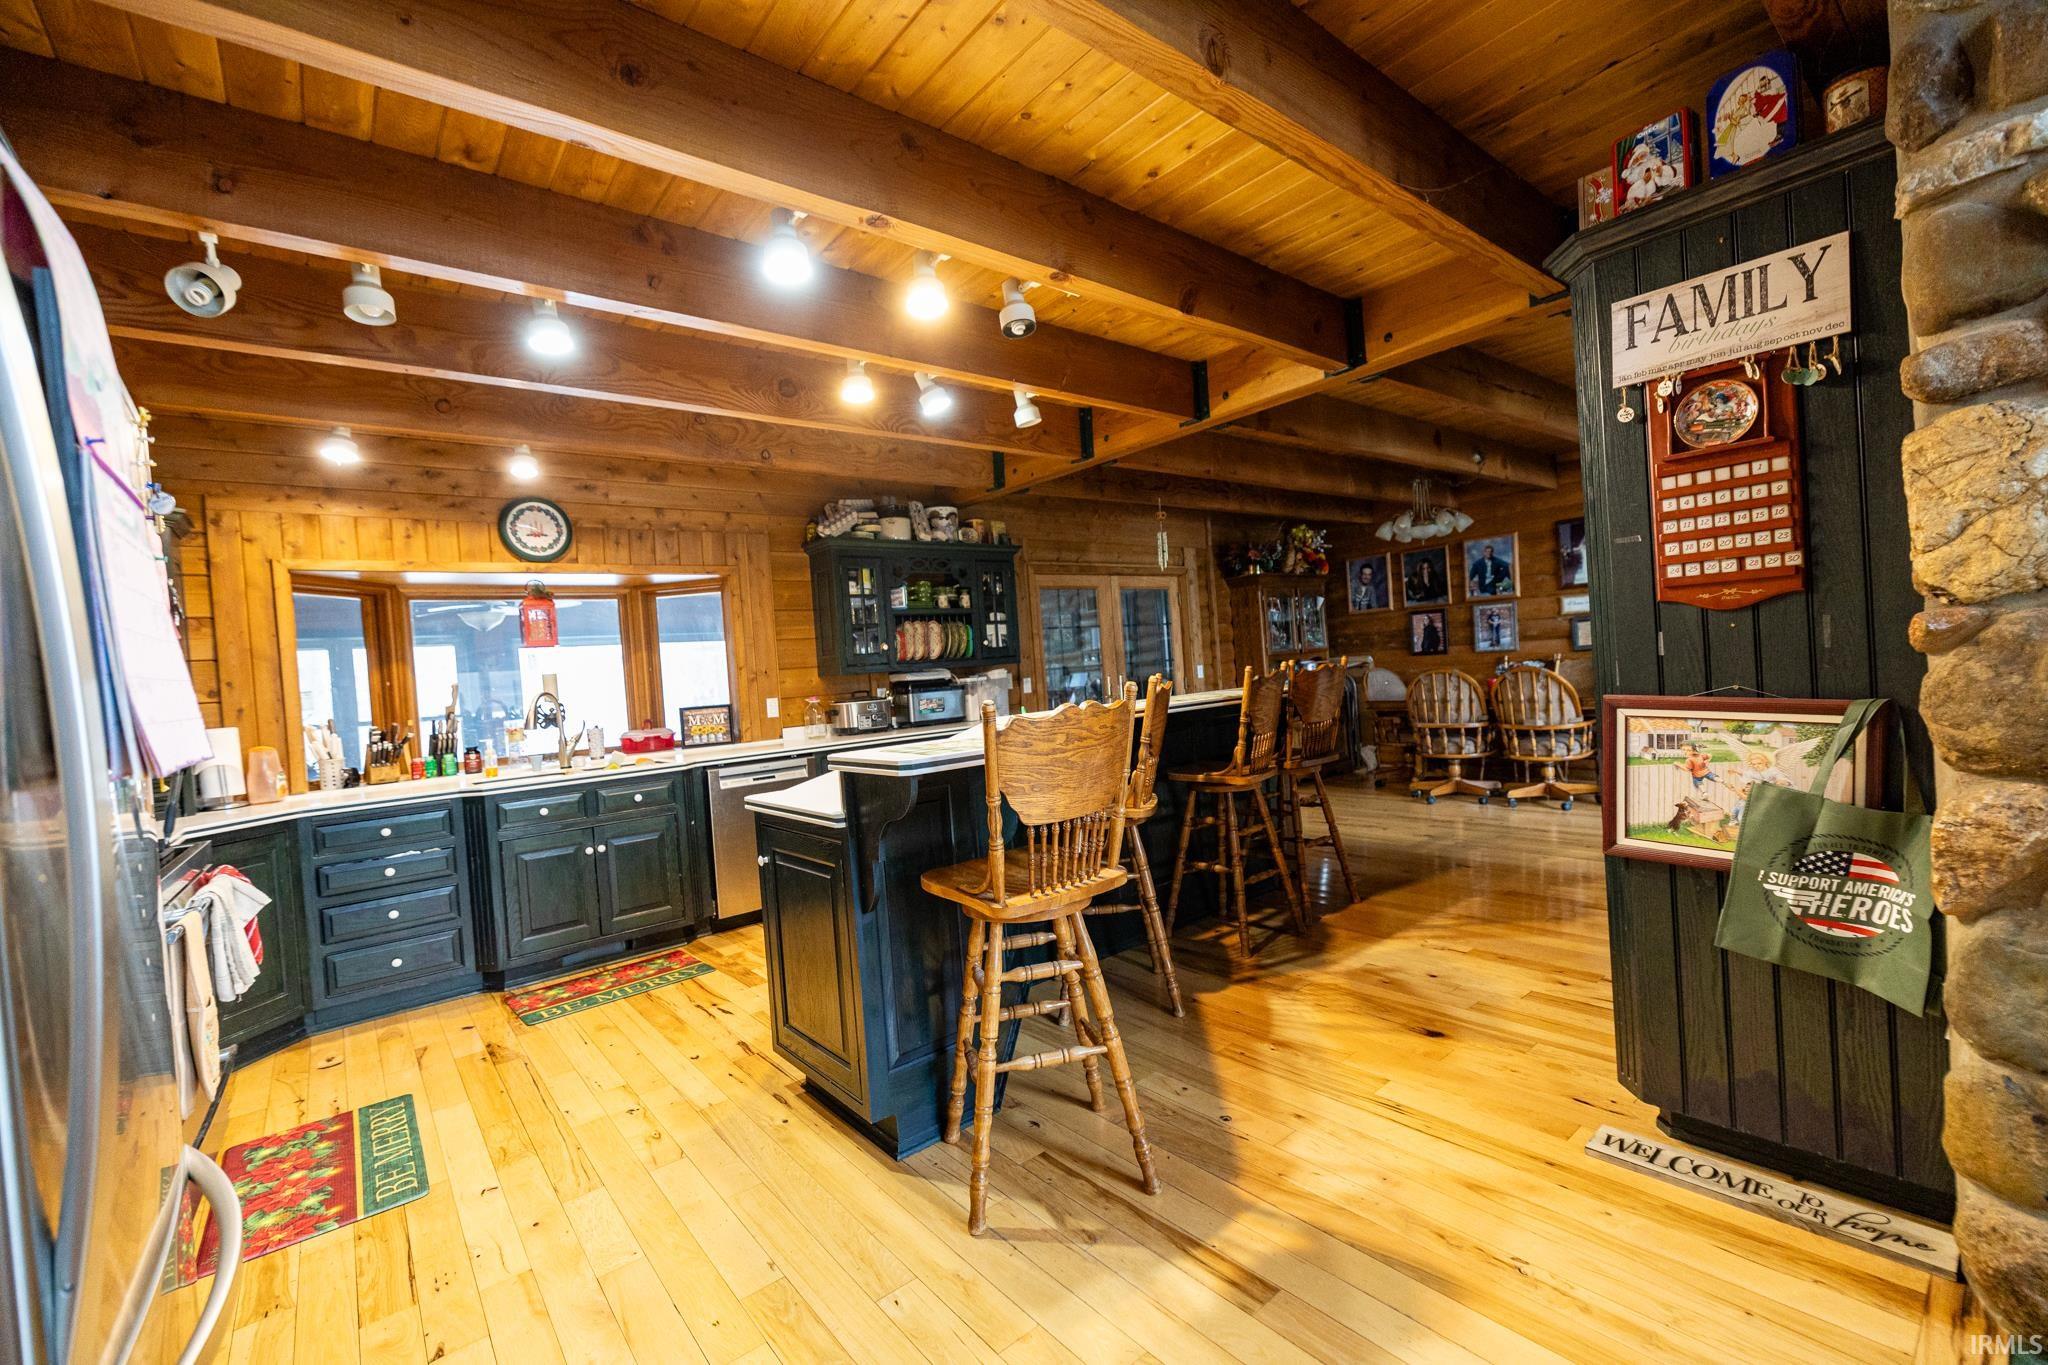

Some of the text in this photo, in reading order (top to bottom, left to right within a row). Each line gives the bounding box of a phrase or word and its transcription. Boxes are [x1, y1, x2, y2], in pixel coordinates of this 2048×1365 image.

[1625, 244, 1832, 351] FAMILY
[1617, 320, 1846, 384] jan feb mar apr may jun jul aug sep oct nov dec
[1668, 315, 1777, 353] birthdays
[1757, 869, 1917, 907] I SUPPORT AMERICA'S
[1807, 892, 1915, 934] HEROES
[538, 965, 703, 1019] BE MERRY
[369, 1102, 418, 1202] BE MERRY
[1602, 1133, 1938, 1252] WELCOME TO OUR home
